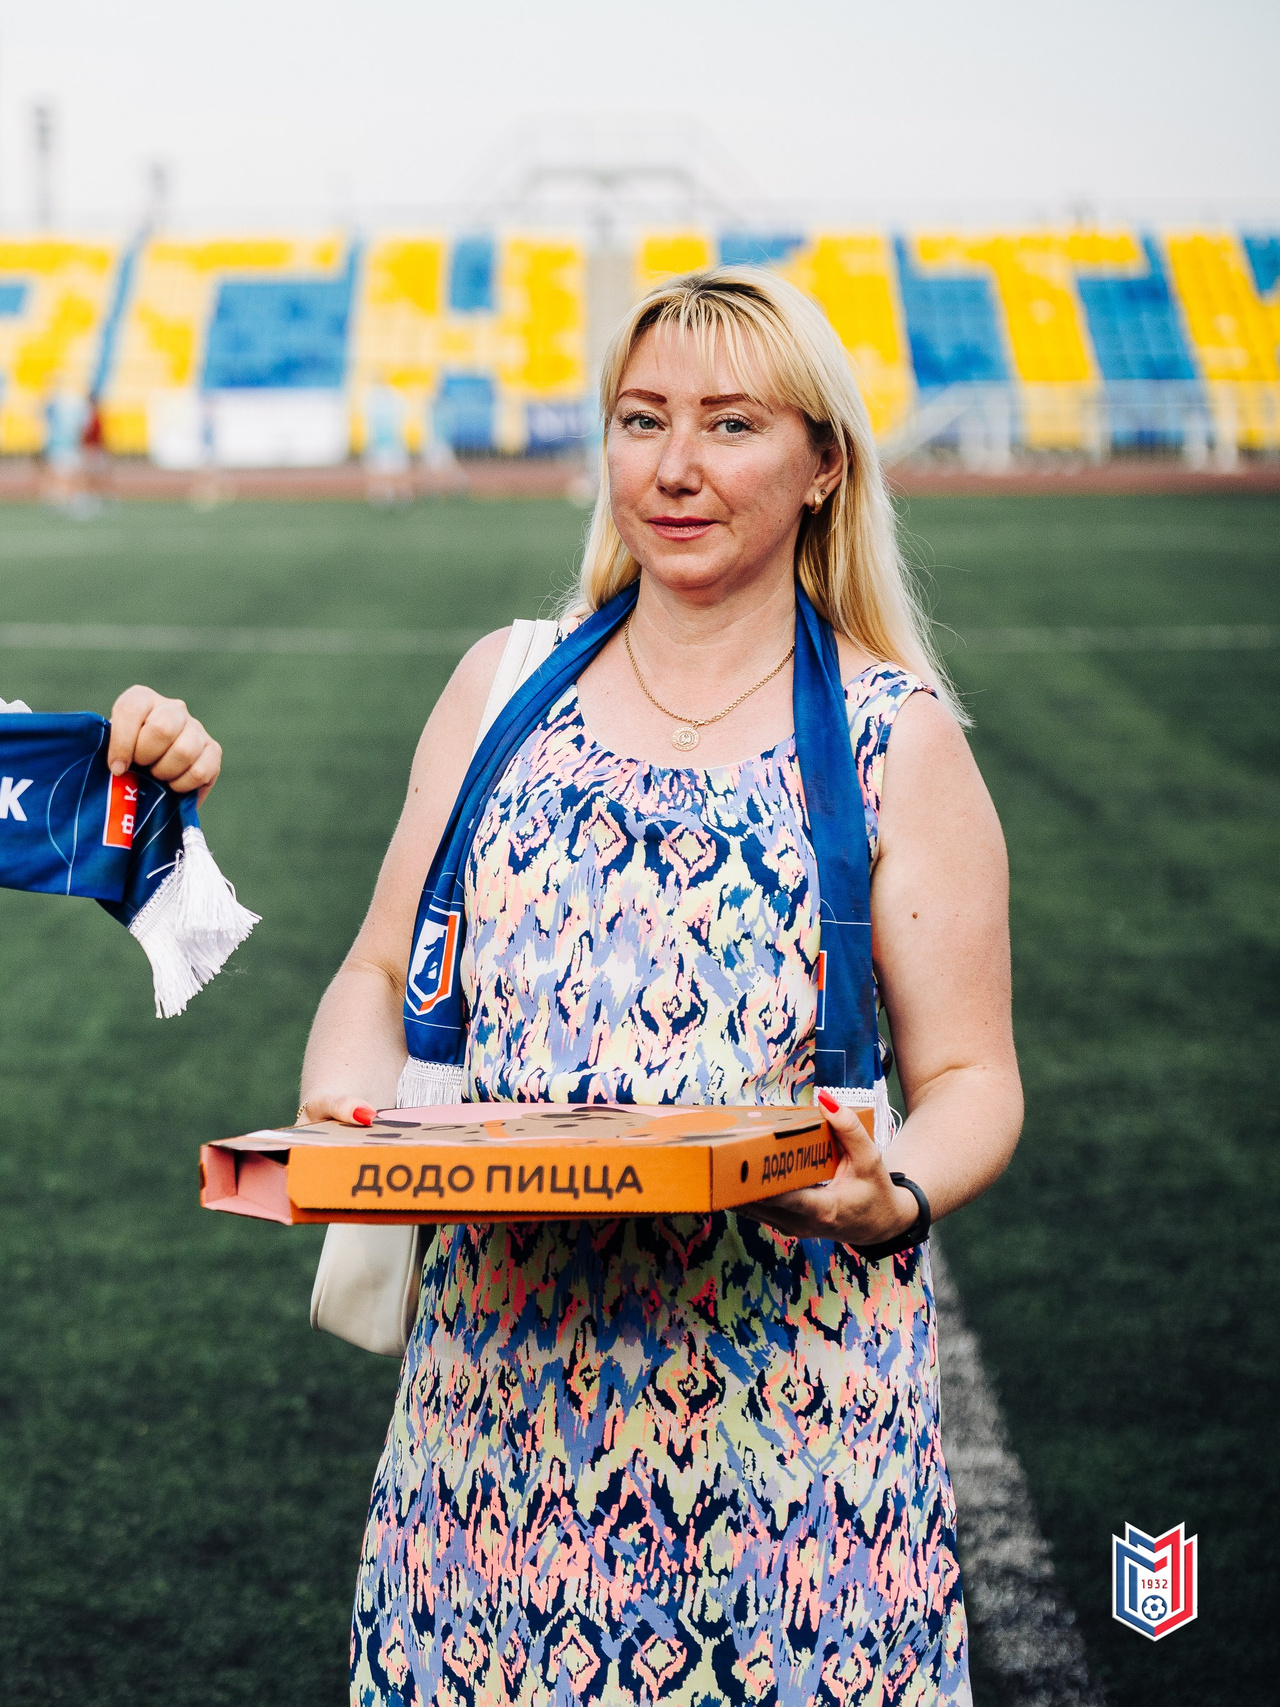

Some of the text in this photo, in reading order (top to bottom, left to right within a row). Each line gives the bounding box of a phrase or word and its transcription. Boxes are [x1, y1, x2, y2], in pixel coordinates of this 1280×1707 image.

[351, 1164, 644, 1200] ДОДО ПИЦЦА
[761, 1140, 833, 1185] ДОДО ПИЦЦА
